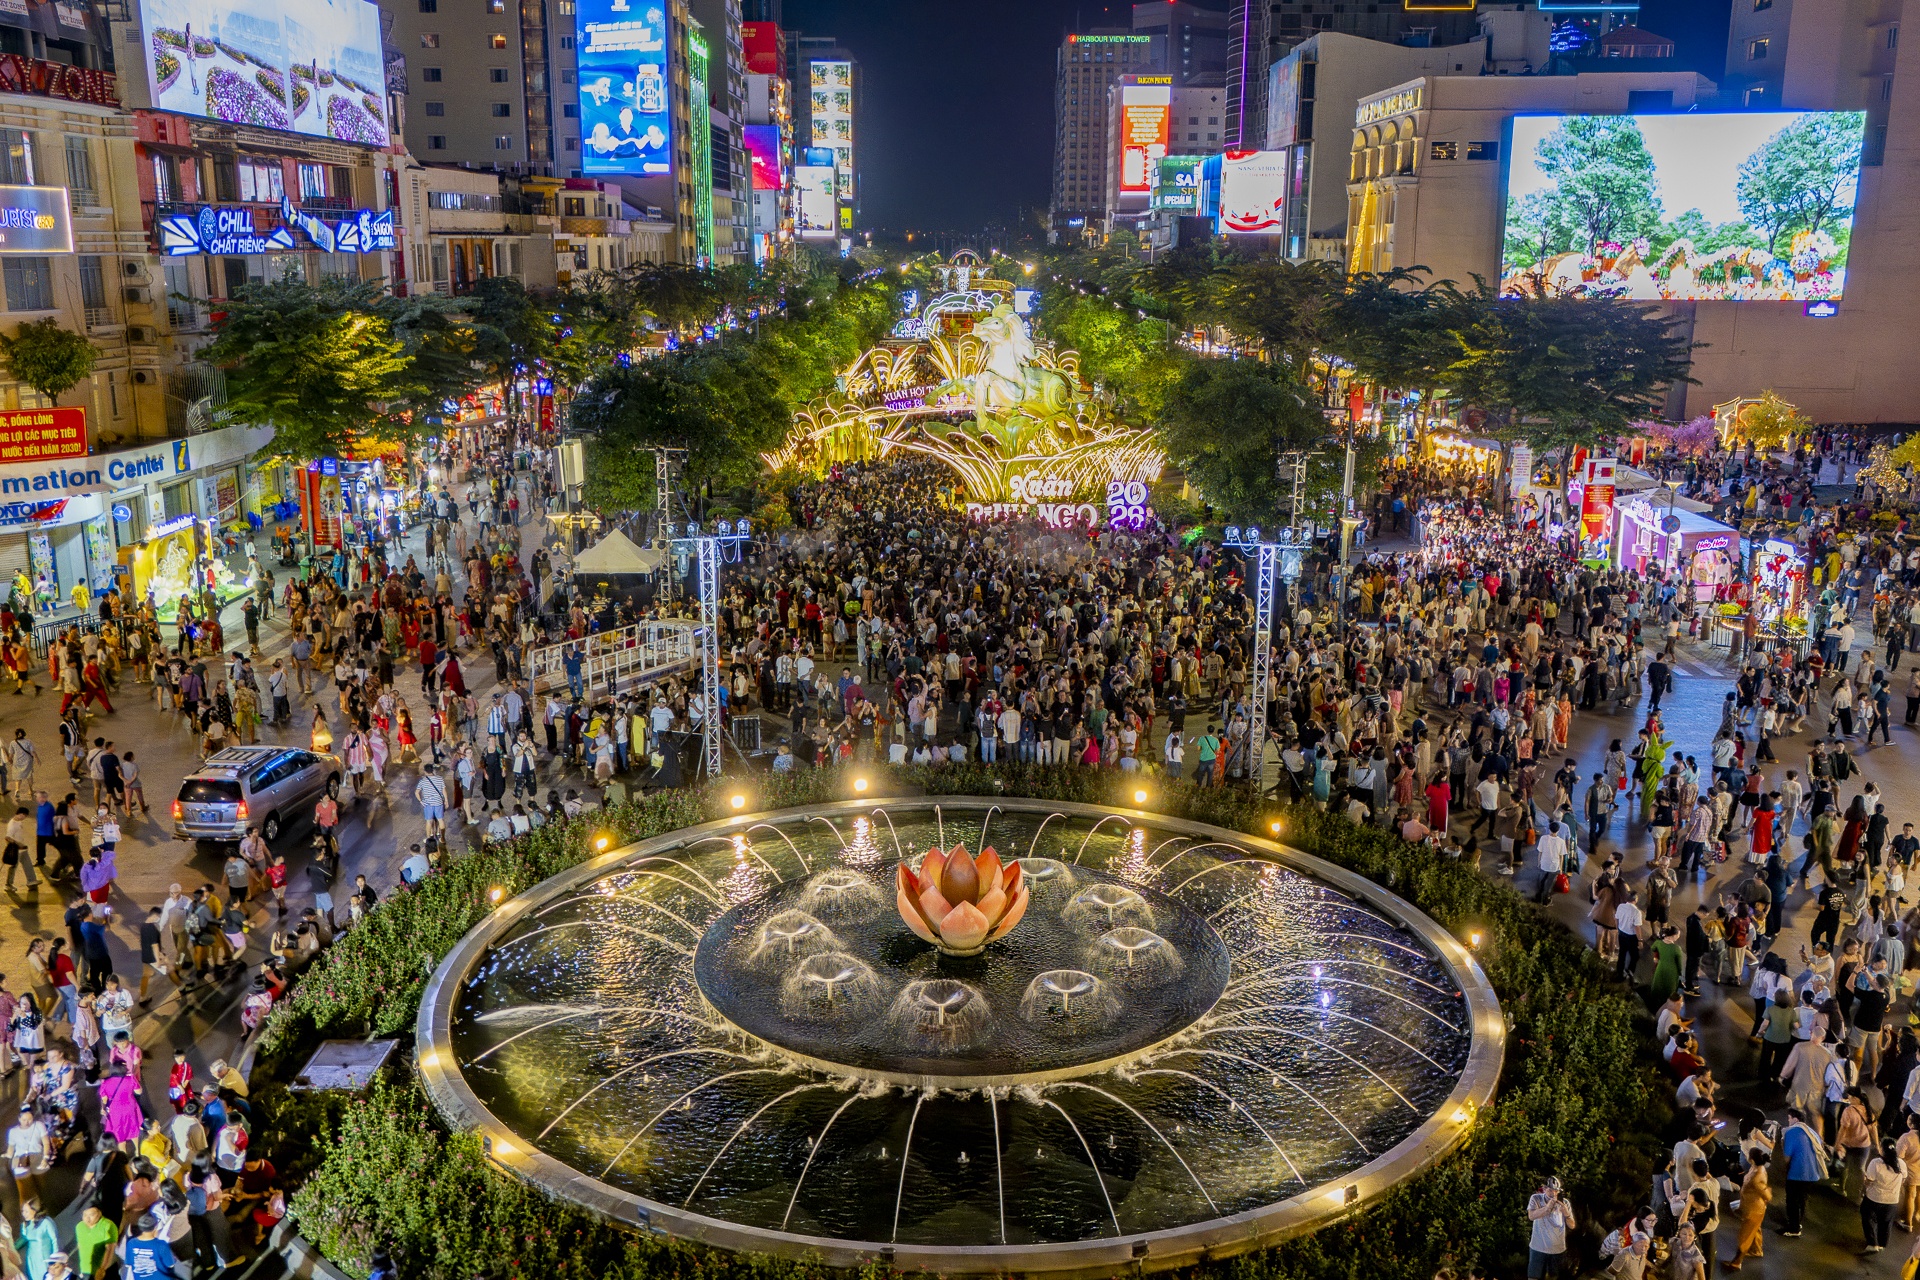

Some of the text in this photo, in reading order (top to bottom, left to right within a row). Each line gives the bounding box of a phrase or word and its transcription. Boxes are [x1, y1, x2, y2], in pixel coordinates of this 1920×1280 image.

[1077, 35, 1149, 43] HARBOUR VIEW TOWER
[44, 61, 119, 107] ZONE
[1137, 76, 1172, 85] SAIGON PRINCE
[218, 211, 254, 233] CHILL
[373, 222, 394, 235] SAIGON
[210, 233, 265, 254] CHẤT RIÊNG
[10, 413, 32, 427] ĐỒNG
[33, 412, 54, 425] LÒNG
[11, 430, 23, 443] LỢI
[24, 428, 40, 441] CÁC
[41, 429, 59, 441] MỤC
[60, 426, 77, 438] TIÊU
[1, 442, 81, 457] NƯỚC ĐẾN NĂM 2030!
[2, 453, 165, 494] mation Center
[1010, 470, 1073, 503] Xuân
[1107, 482, 1147, 506] 20
[1109, 505, 1146, 530] 26
